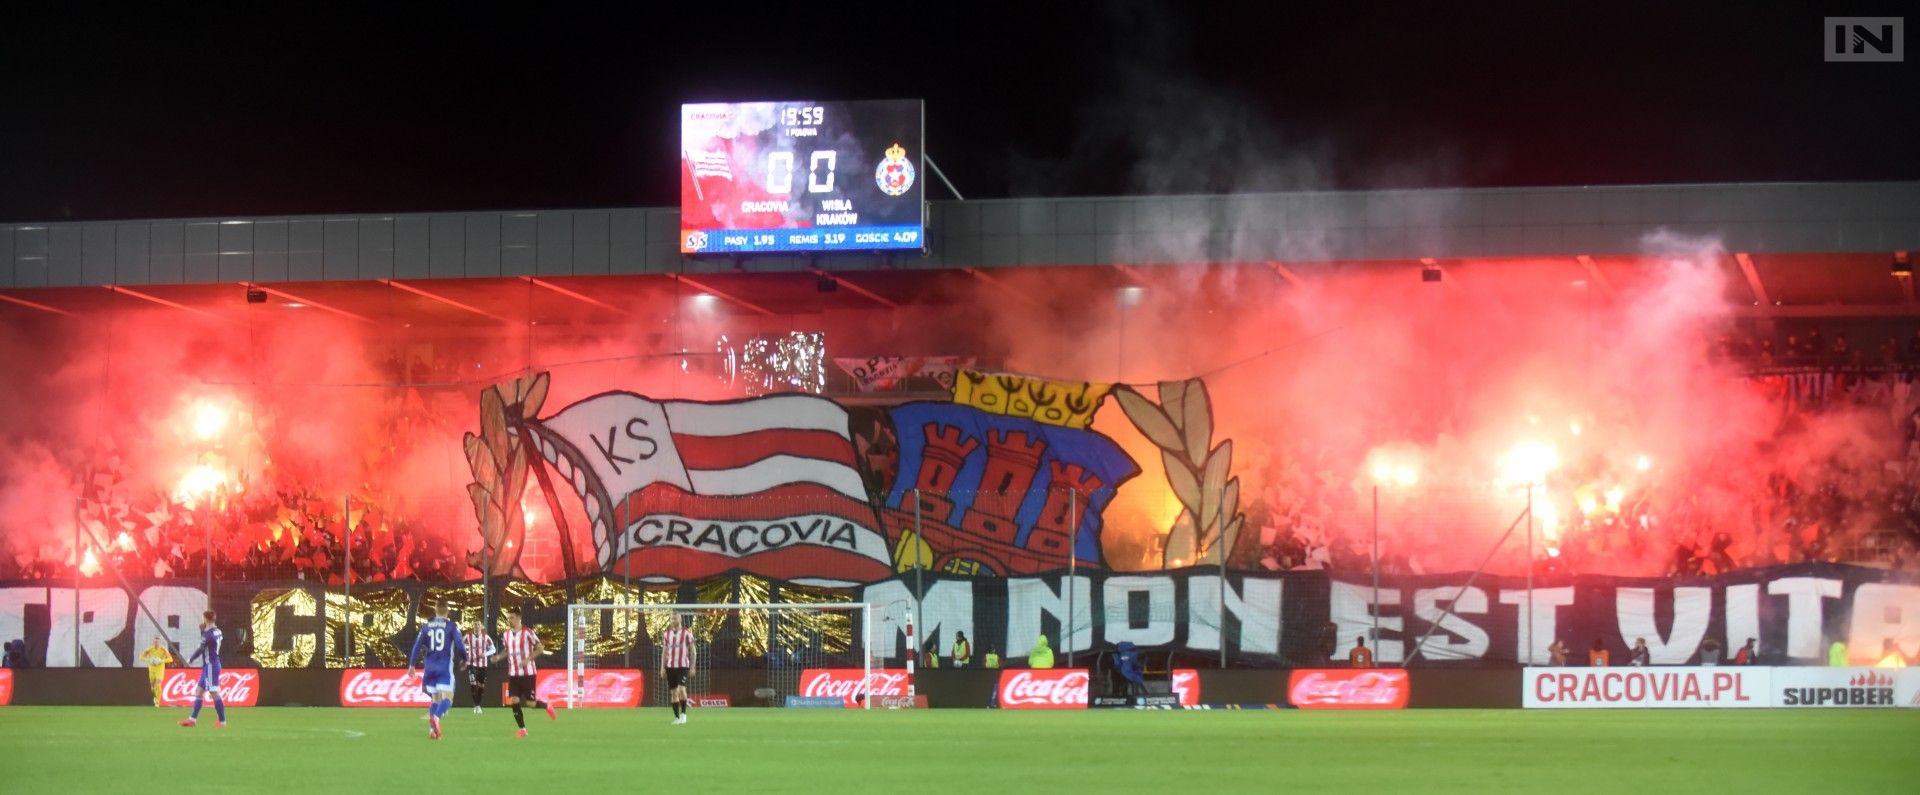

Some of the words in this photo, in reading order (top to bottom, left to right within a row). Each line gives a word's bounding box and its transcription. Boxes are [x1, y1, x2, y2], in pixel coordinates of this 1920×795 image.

[781, 106, 824, 125] 19:59
[767, 151, 794, 194] 0
[808, 150, 837, 193] 0
[741, 201, 789, 213] CRACOVIA
[816, 212, 857, 226] KRAKÓW
[724, 236, 748, 245] PASY
[789, 235, 818, 244] REMIS
[824, 233, 846, 244] 3.19
[893, 231, 918, 242] 4.09
[589, 417, 658, 475] KS
[633, 518, 857, 554] CRACOVIA
[1006, 574, 1283, 659] NON
[1330, 580, 1575, 665] EST
[1615, 577, 1920, 666] VITA
[427, 629, 445, 651] 19
[1535, 672, 1750, 702] CRACOVIA.PL
[1783, 687, 1894, 705] SUPOBER
